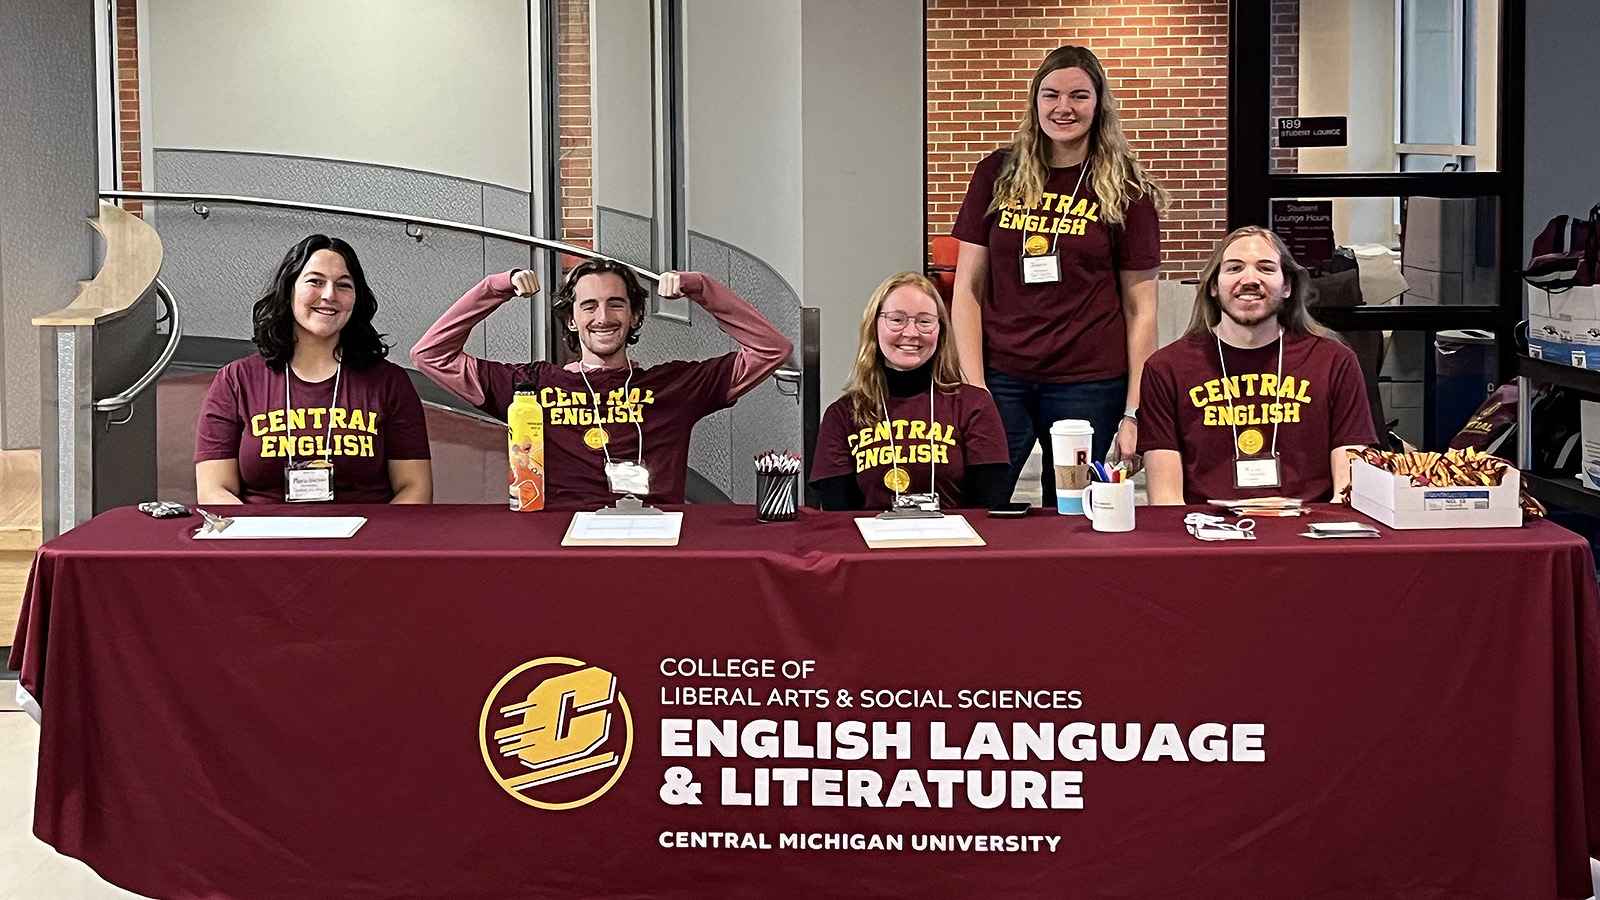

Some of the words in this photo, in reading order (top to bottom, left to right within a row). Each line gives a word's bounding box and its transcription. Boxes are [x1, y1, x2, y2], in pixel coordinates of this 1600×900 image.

[1281, 119, 1302, 129] 189
[1313, 128, 1341, 136] LOUNGE
[1274, 214, 1304, 223] Lounge
[1306, 214, 1330, 222] Hours
[1287, 204, 1318, 212] Student
[999, 210, 1088, 235] ENGLISH
[1189, 374, 1312, 408] CENTRAL
[251, 407, 378, 437] CENTRAL
[550, 403, 644, 426] ENGLISH
[1203, 402, 1301, 426] ENGLISH
[260, 434, 375, 457] ENGLISH
[847, 420, 956, 456] CENTRAL
[856, 444, 949, 473] ENGLISH
[660, 658, 776, 678] COLLEGE
[782, 660, 815, 679] OF
[661, 687, 761, 706] LIBERAL
[767, 688, 829, 708] ARTS
[836, 689, 853, 707] &
[861, 690, 952, 708] SOCIAL
[958, 690, 1083, 709] SCIENCES
[661, 719, 911, 761] ENGLISH
[930, 722, 1266, 762] LANGUAGE
[660, 767, 702, 806] &
[722, 768, 1084, 810] LITERATURE
[659, 831, 771, 850] CENTRAL
[780, 833, 902, 851] MICHIGAN
[912, 834, 1062, 853] UNIVERSITY
